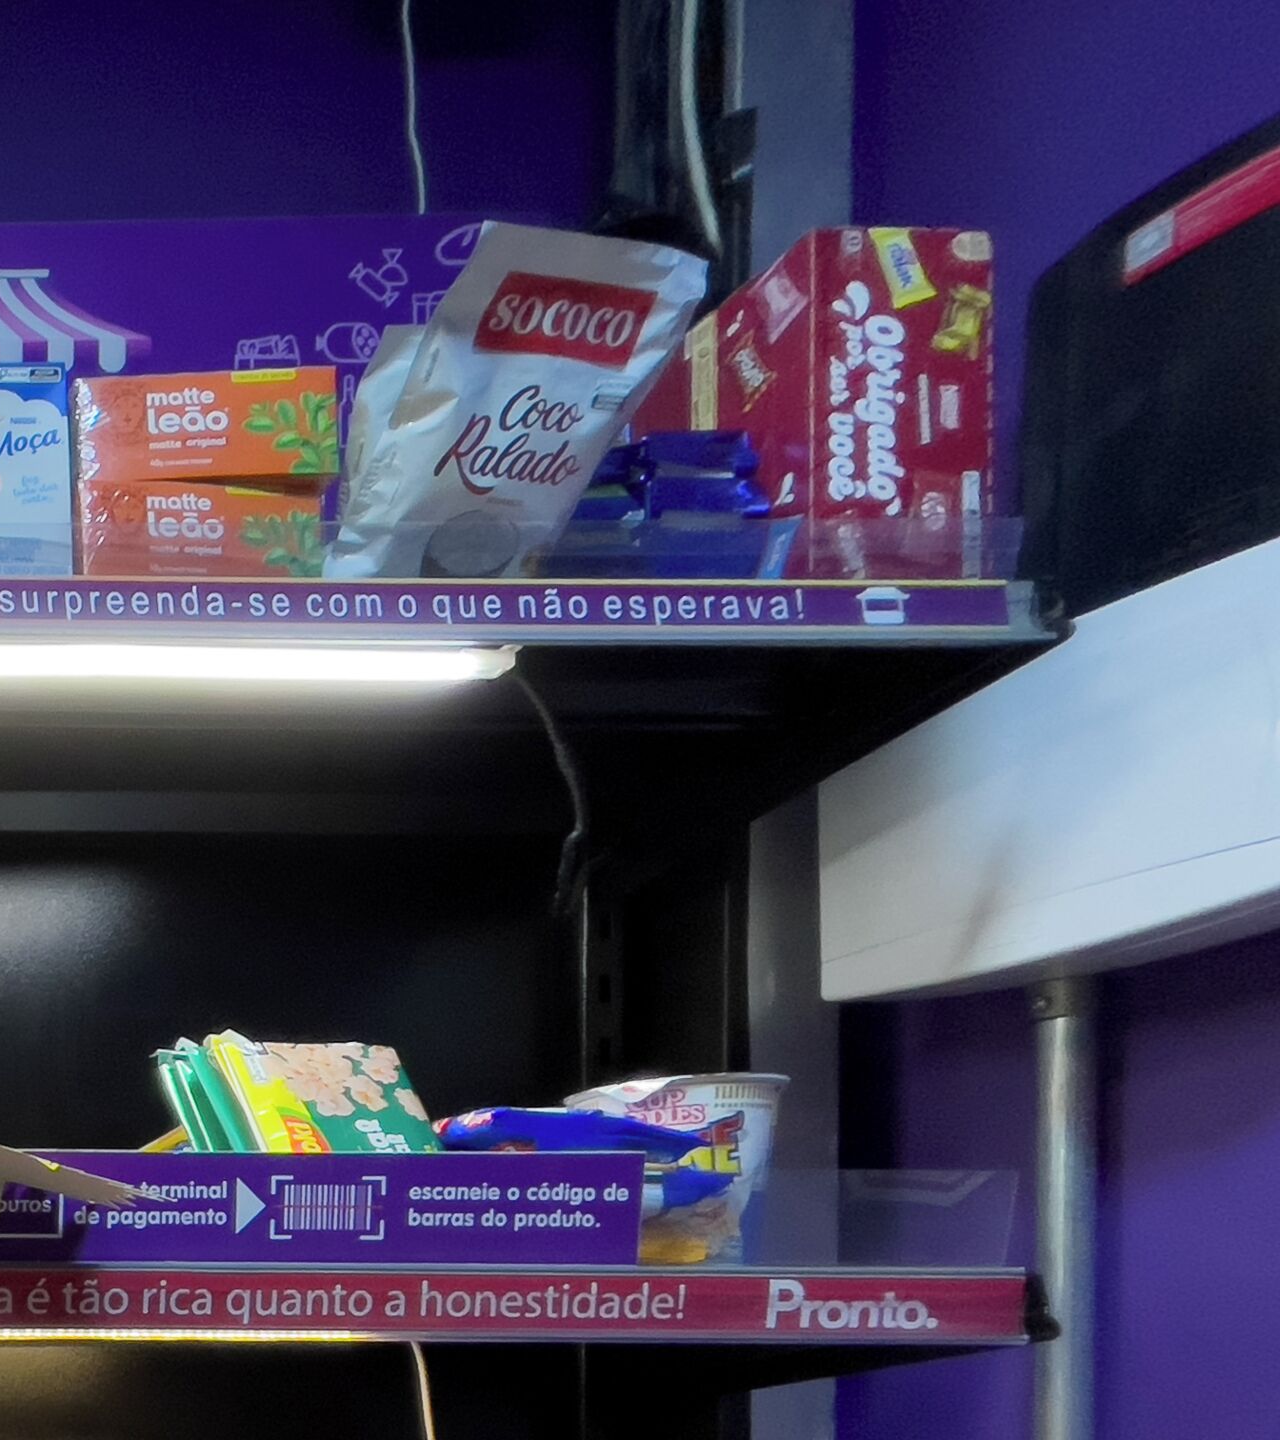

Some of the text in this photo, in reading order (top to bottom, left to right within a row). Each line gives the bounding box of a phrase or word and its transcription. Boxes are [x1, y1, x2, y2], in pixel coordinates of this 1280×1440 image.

[491, 294, 640, 349] SOCOCO
[146, 387, 216, 407] matte
[498, 385, 583, 433] Coco
[146, 406, 226, 435] leão
[435, 412, 581, 497] Ralado
[146, 494, 213, 512] matte
[146, 512, 225, 540] leão
[306, 590, 383, 617] com
[398, 591, 419, 618] o
[432, 591, 503, 628] que
[519, 586, 589, 620] não
[603, 588, 806, 628] esperava!
[408, 1182, 630, 1207] escaneie o código de
[74, 1206, 228, 1229] de pagamento
[407, 1208, 602, 1232] barras do produto.
[27, 1281, 50, 1316] é
[62, 1281, 129, 1316] tão
[142, 1280, 214, 1315] rica
[226, 1284, 374, 1324] quanto
[384, 1291, 406, 1317] a
[420, 1280, 688, 1321] honestidade!
[766, 1279, 940, 1331] Pronto.
